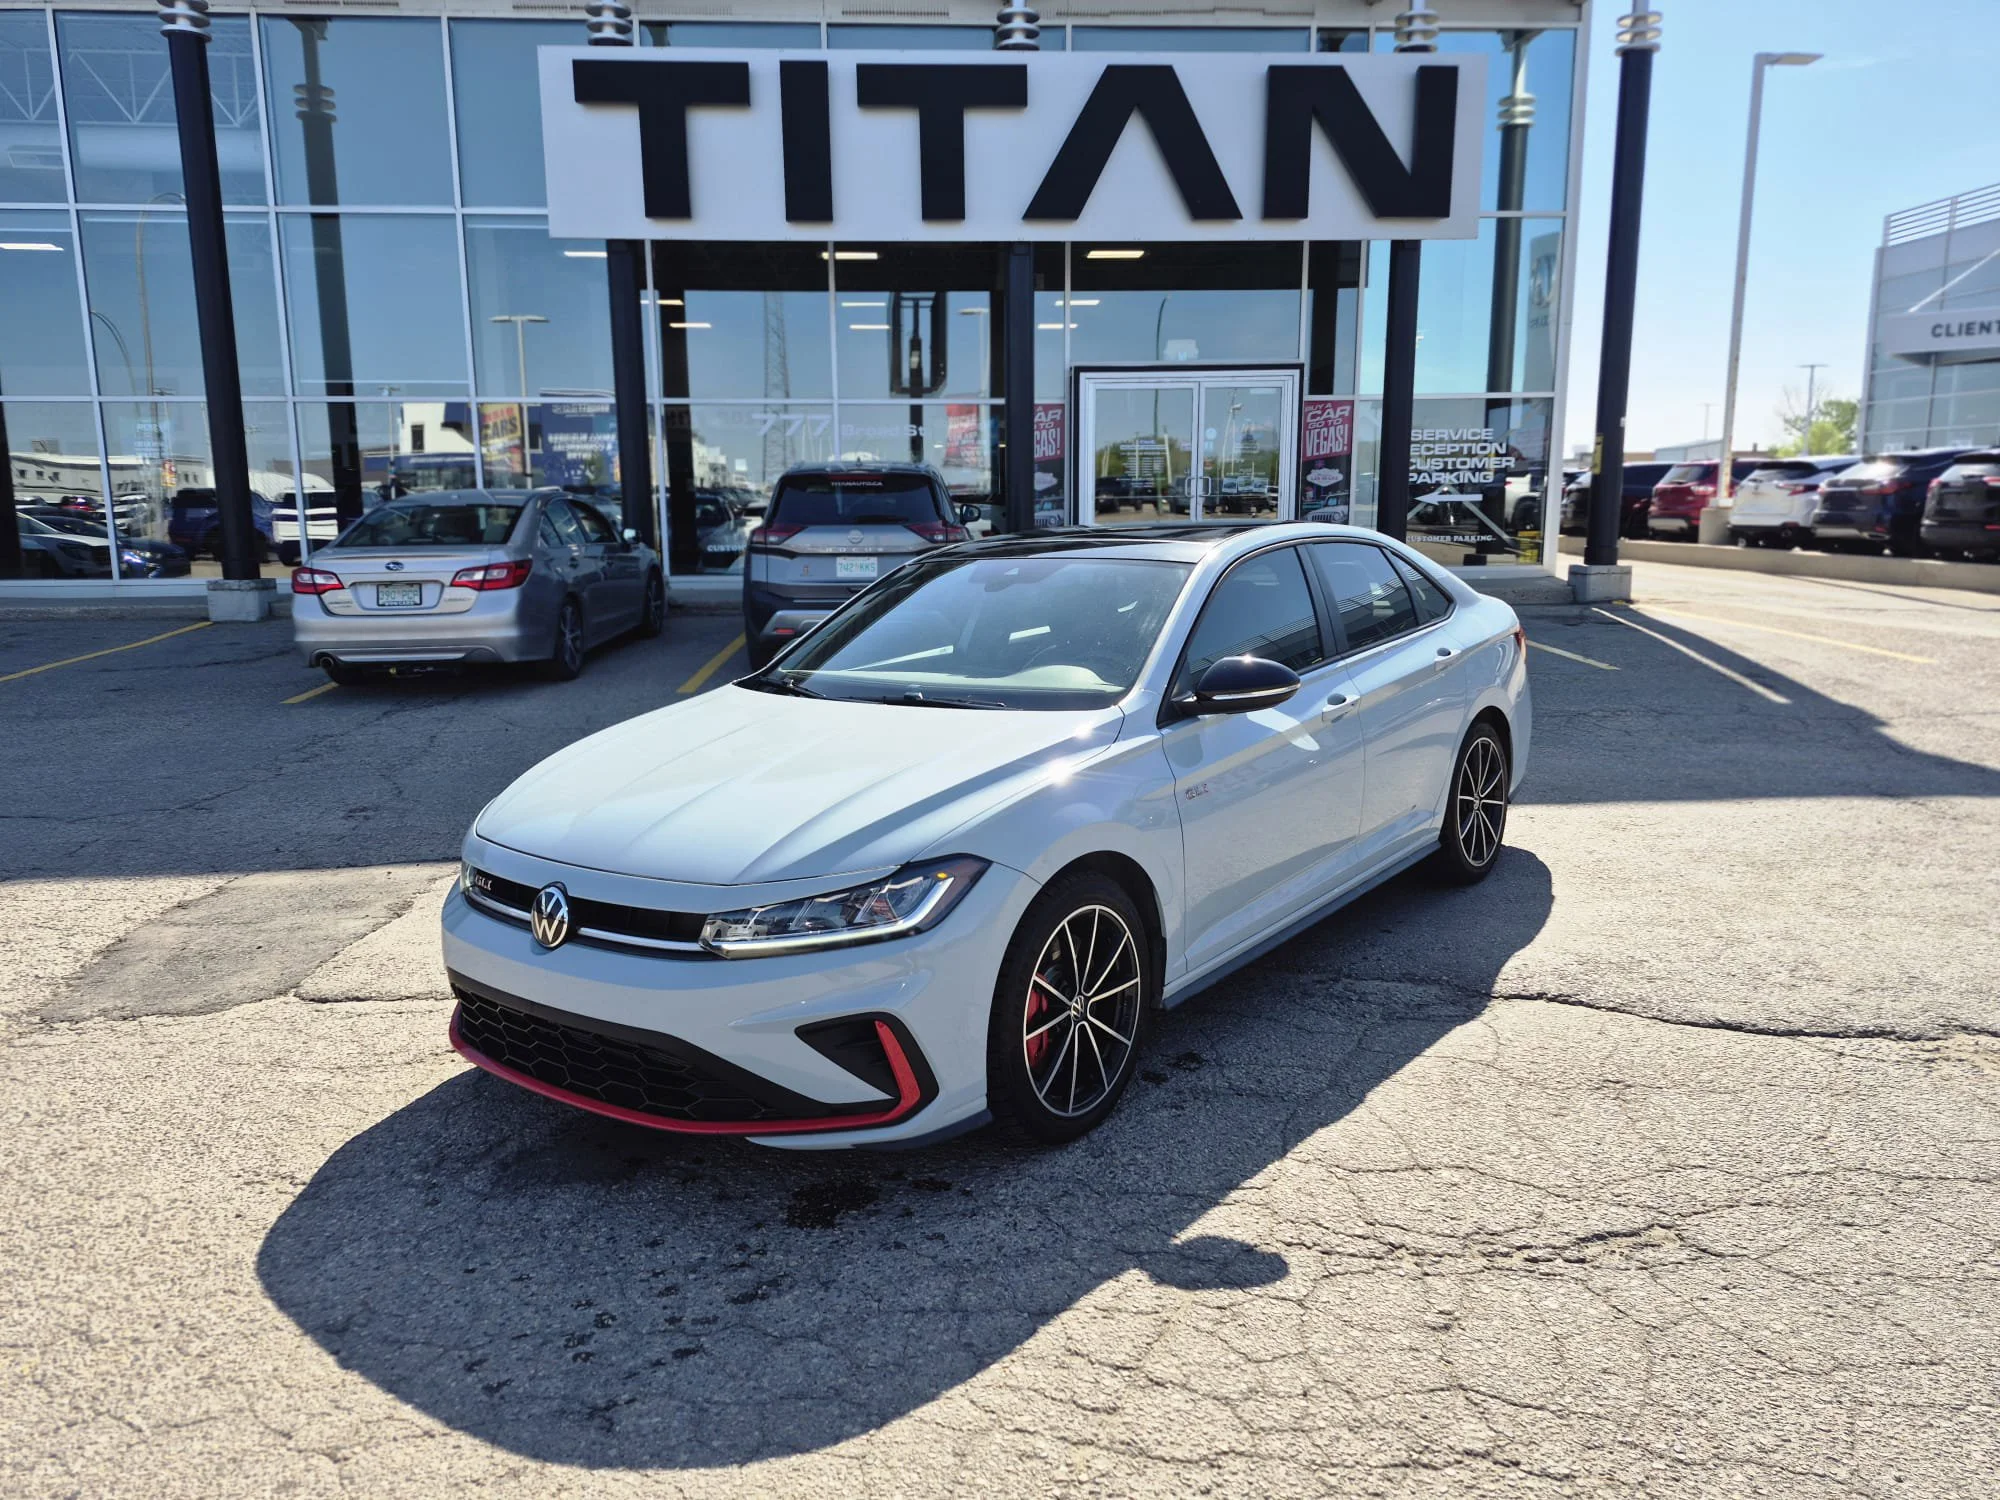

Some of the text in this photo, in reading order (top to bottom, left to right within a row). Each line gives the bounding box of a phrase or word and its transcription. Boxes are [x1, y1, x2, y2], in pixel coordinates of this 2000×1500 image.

[572, 60, 1460, 221] TITAN
[1034, 409, 1062, 421] AR
[1307, 405, 1351, 422] CAR
[1327, 418, 1343, 426] TO
[752, 413, 832, 437] 777
[1034, 428, 1060, 458] GAS!
[1306, 424, 1348, 457] VEGAS!
[1411, 428, 1494, 441] SERVICE
[1410, 442, 1507, 455] ECEPTION
